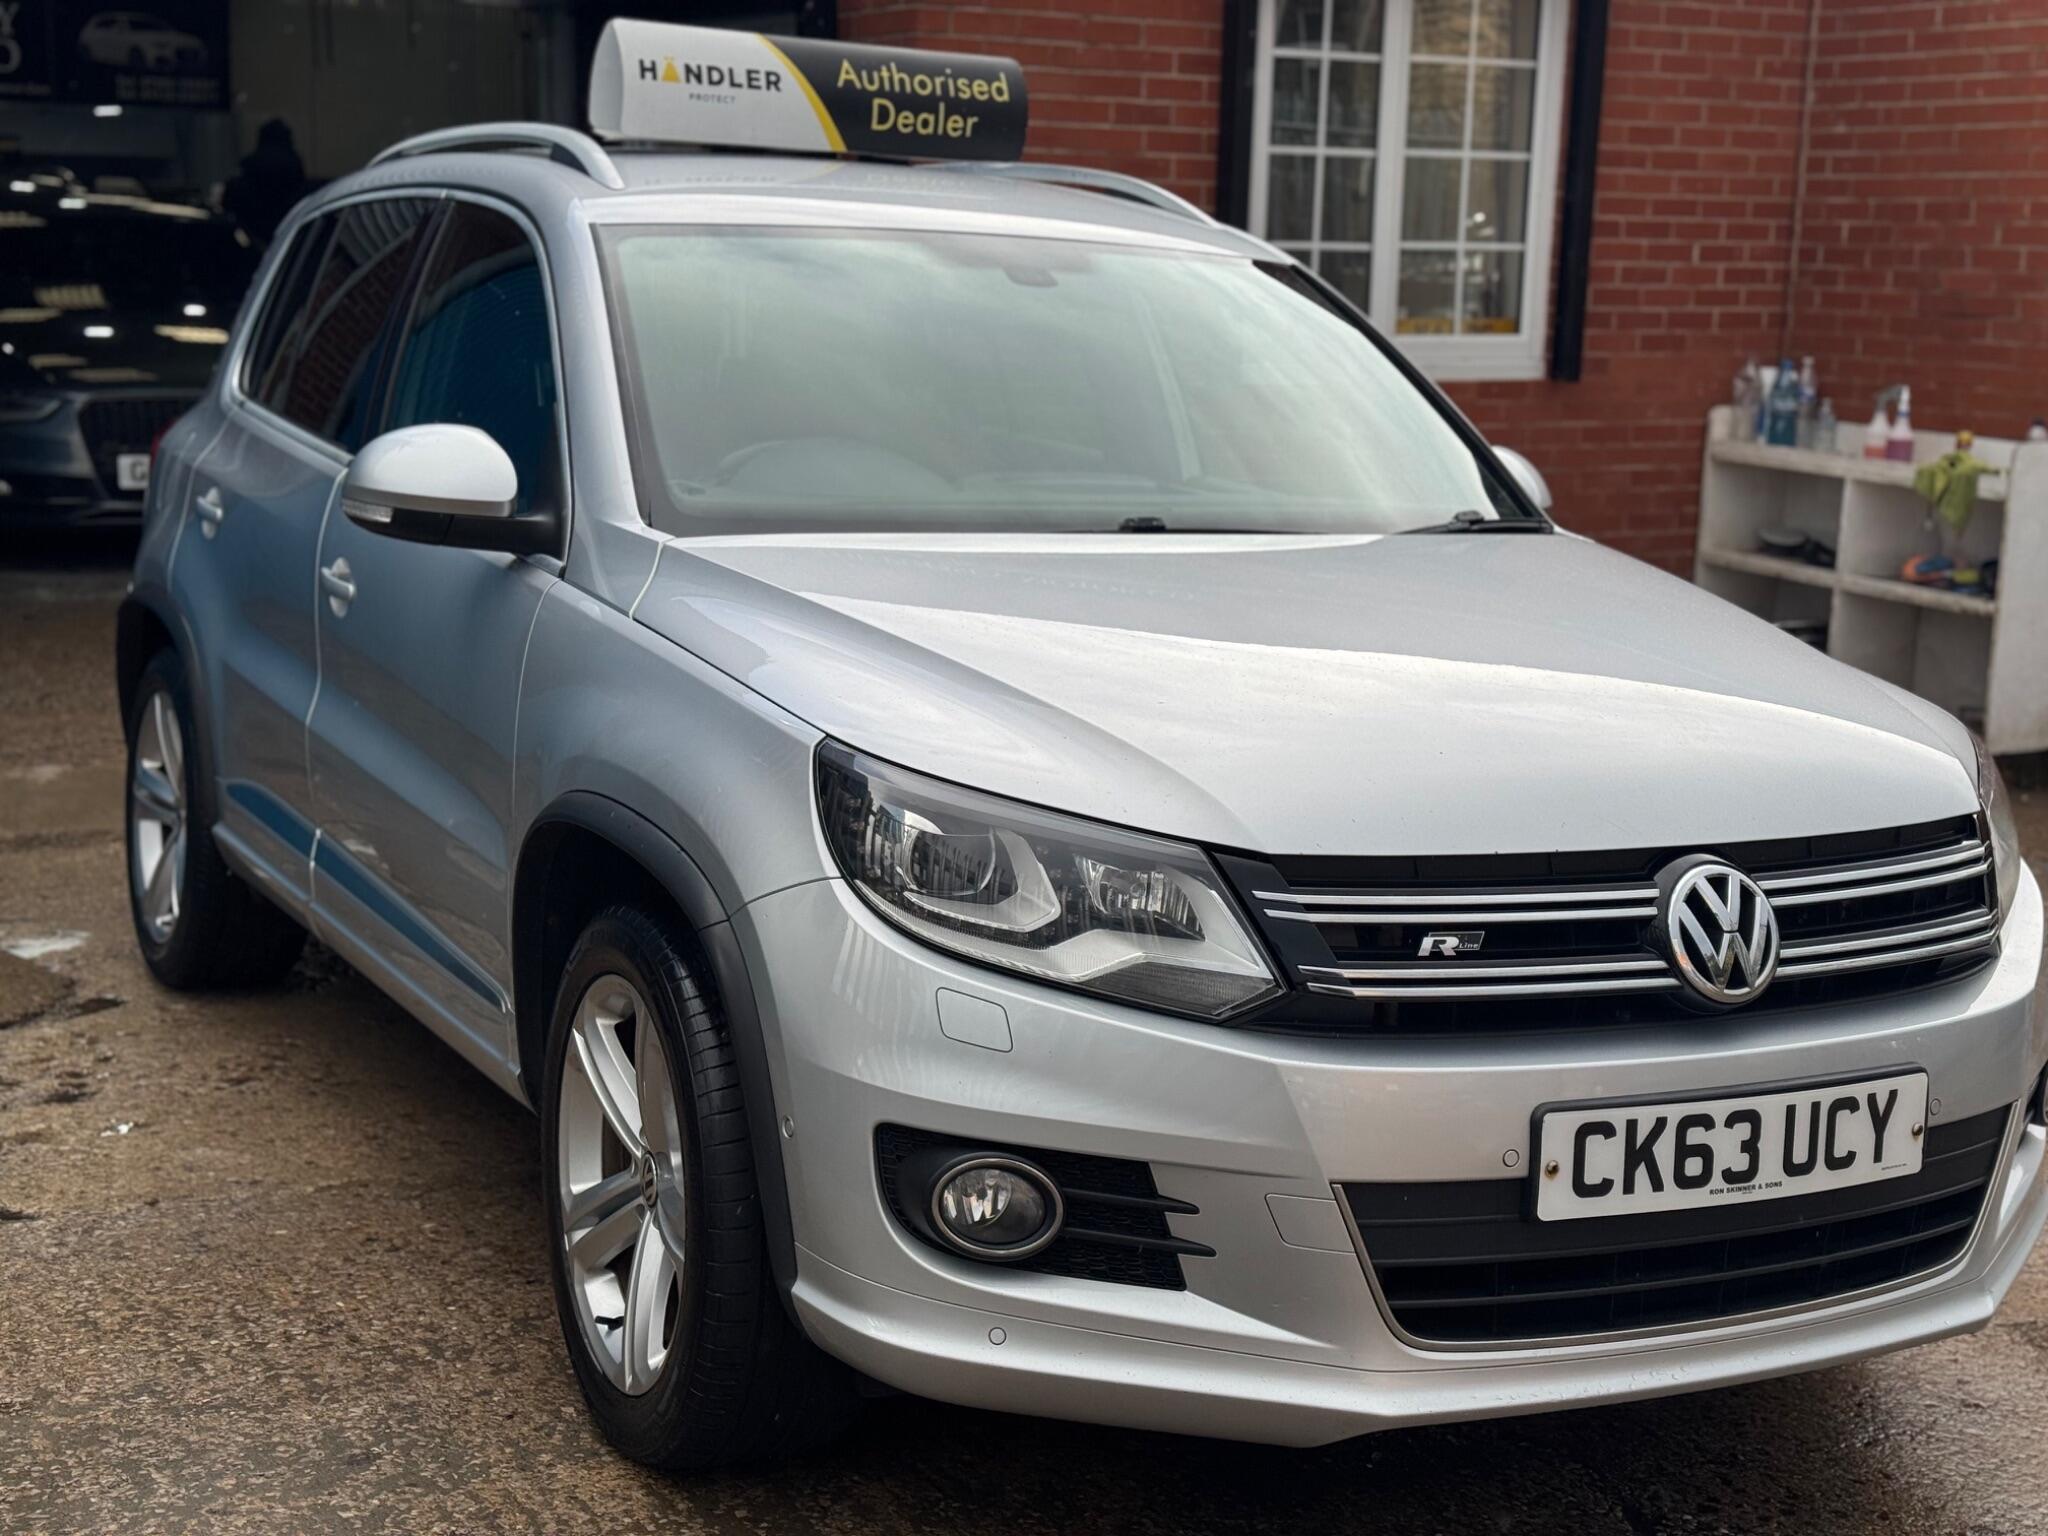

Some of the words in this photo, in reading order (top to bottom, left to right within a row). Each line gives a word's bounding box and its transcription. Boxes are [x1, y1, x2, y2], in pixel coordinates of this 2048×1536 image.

[837, 58, 1010, 103] Authorised
[689, 93, 736, 104] PROTECT
[870, 99, 979, 138] Dealer
[1417, 936, 1459, 956] R
[1572, 1108, 1762, 1198] CK63
[1782, 1089, 1898, 1178] UCY
[1726, 1184, 1756, 1194] SKINNER
[1765, 1181, 1782, 1189] SONS
